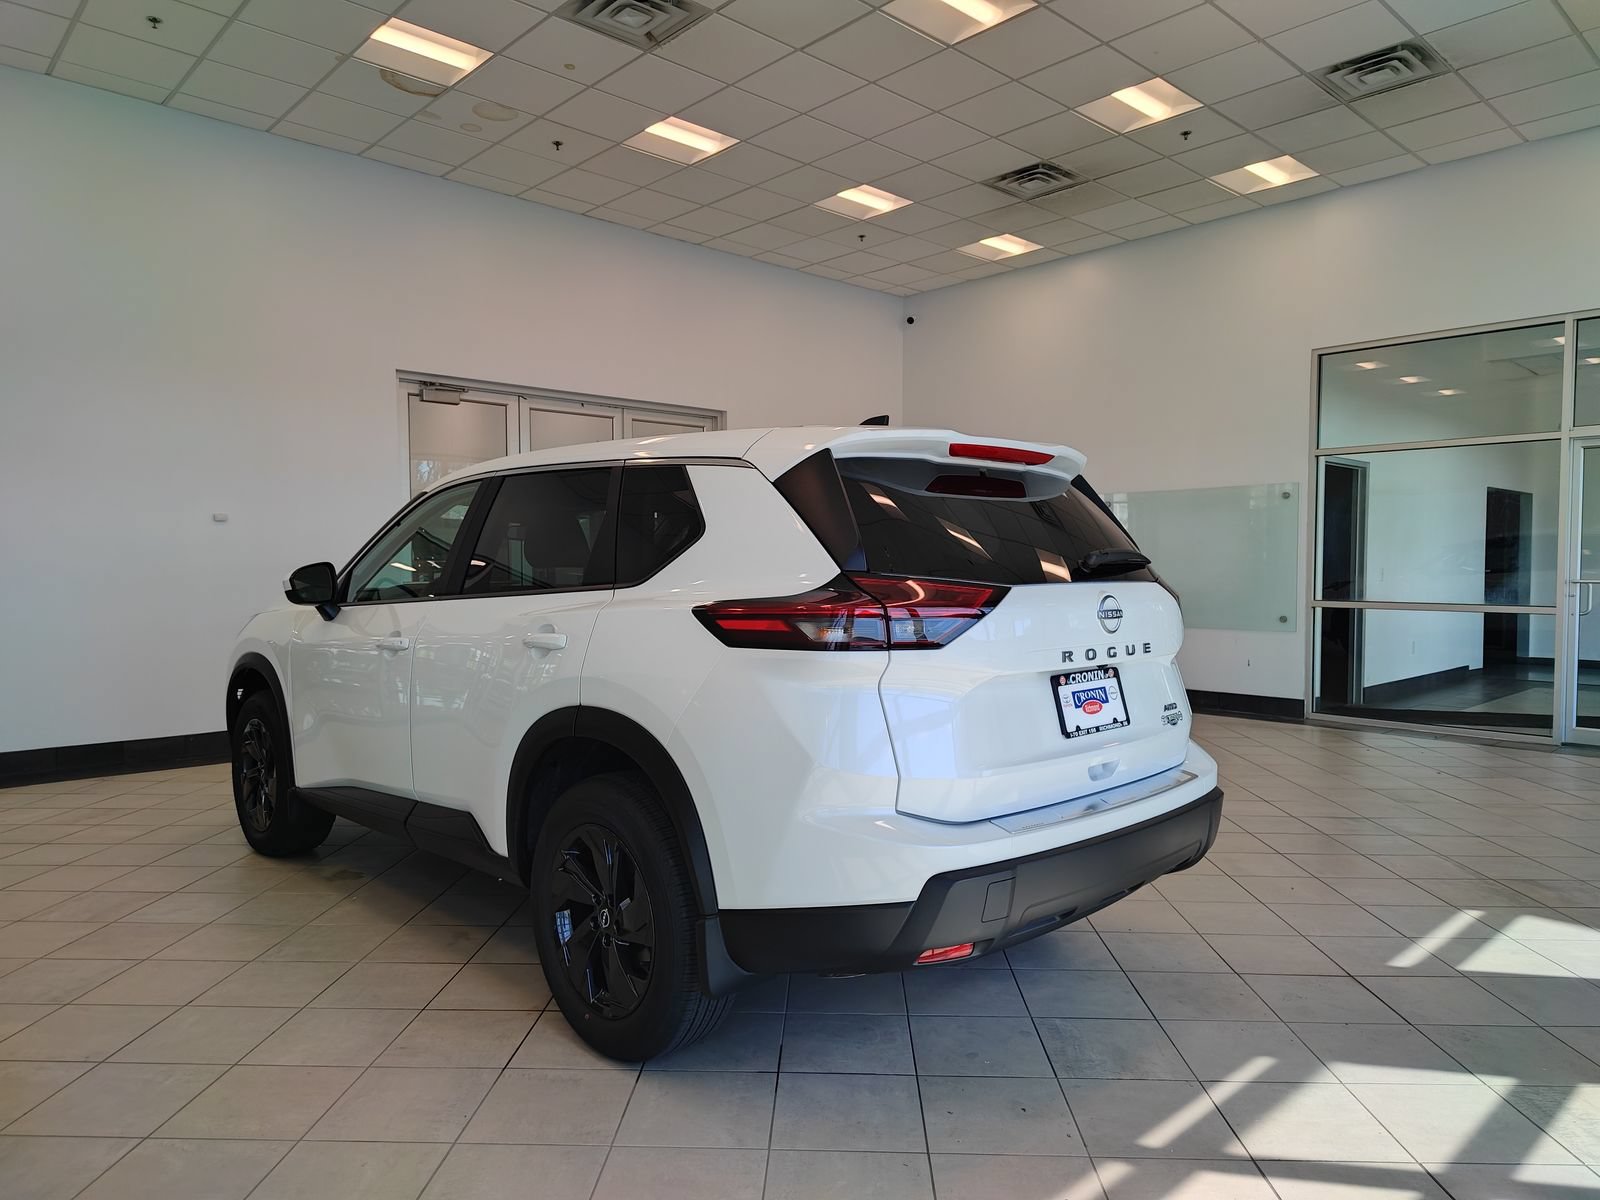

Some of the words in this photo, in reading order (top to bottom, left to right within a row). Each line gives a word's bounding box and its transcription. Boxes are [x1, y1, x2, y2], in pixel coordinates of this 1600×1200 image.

[1098, 610, 1123, 619] NISSAN
[1062, 643, 1151, 663] ROGUE
[1070, 670, 1104, 684] CRONIN
[1075, 689, 1106, 706] CRONIN
